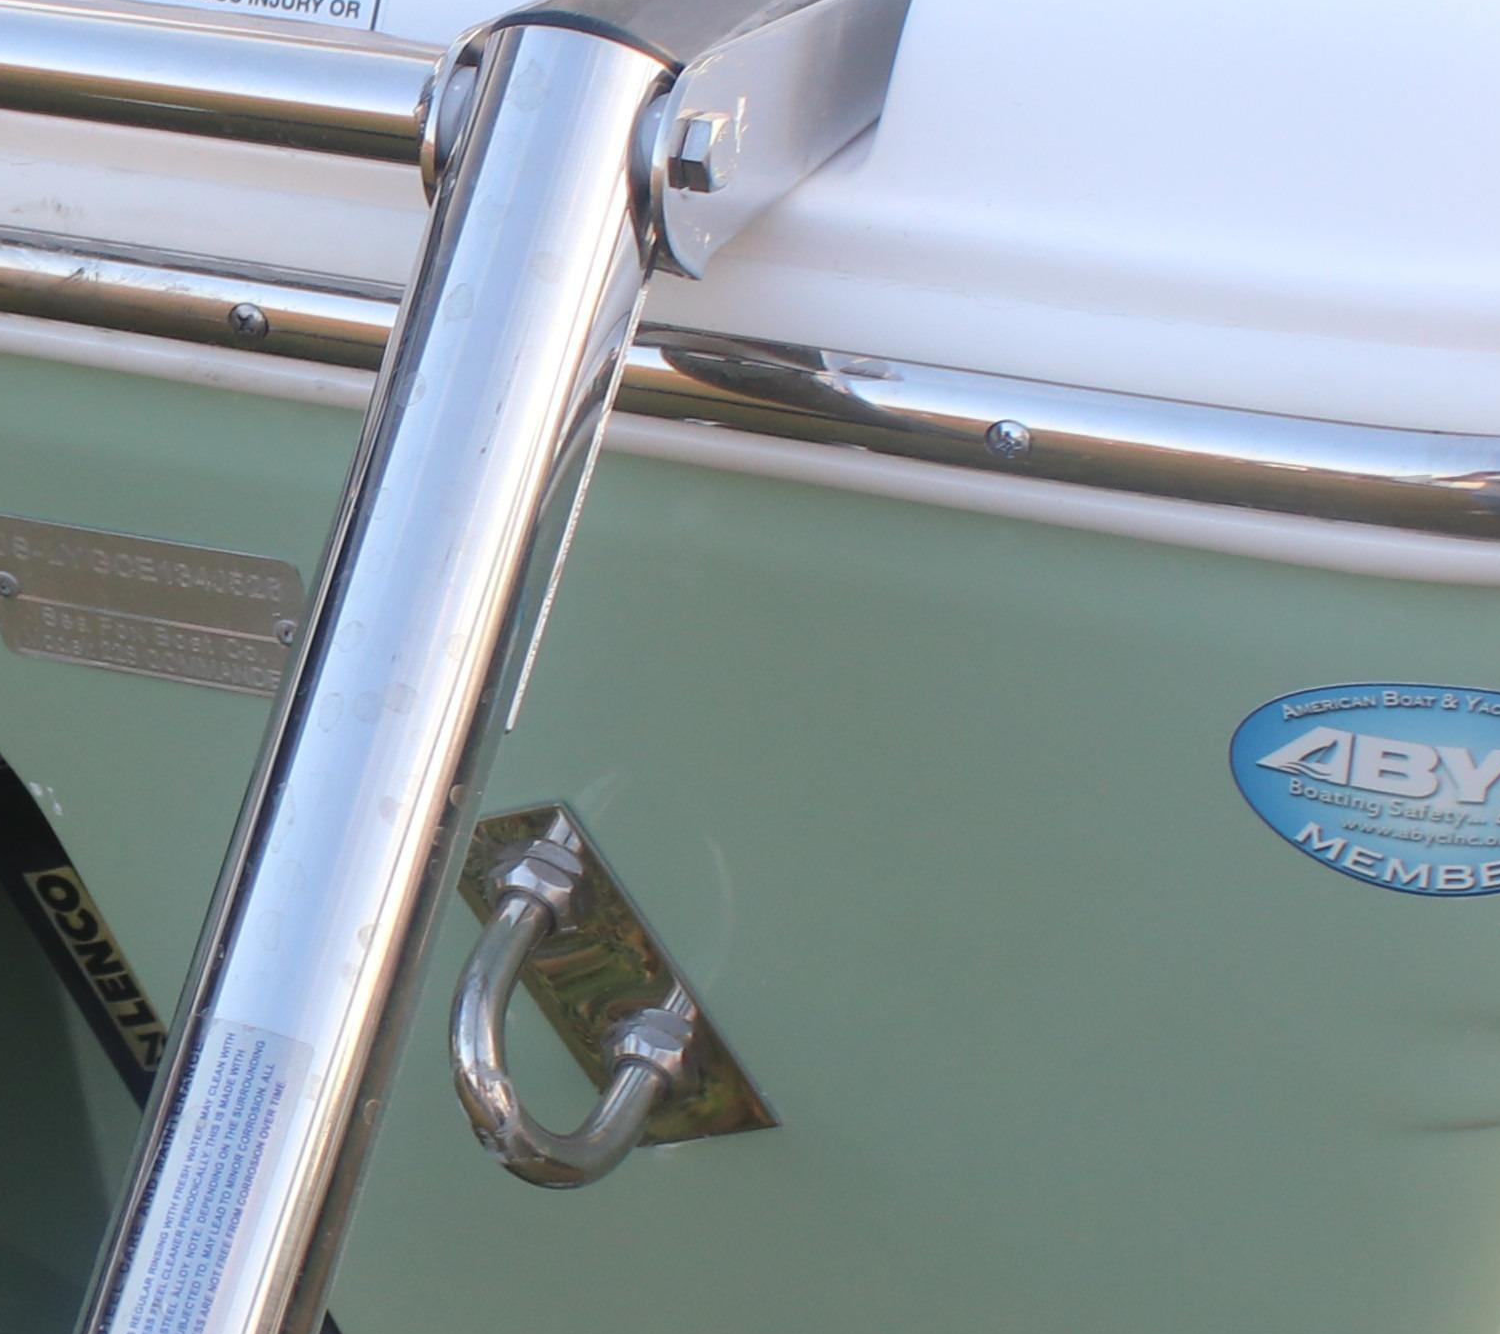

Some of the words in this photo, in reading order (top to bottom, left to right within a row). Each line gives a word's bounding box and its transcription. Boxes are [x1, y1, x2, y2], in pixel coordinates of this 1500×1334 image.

[1280, 693, 1378, 722] AMERICAN
[1382, 690, 1437, 709] BOAT
[1441, 692, 1459, 710] &
[1288, 777, 1382, 817] Boating
[35, 874, 155, 1029] LENCO
[228, 1047, 246, 1076] WITH
[260, 1061, 275, 1083] ALL
[217, 1076, 236, 1109] MADE
[230, 1038, 266, 1119] SURROUNDING
[213, 1109, 225, 1122] IS
[223, 1118, 239, 1141] THE
[258, 1107, 276, 1139] OVER
[205, 1122, 221, 1148] THIS
[217, 1142, 231, 1159] ON
[128, 1275, 154, 1329] REGULAR
[146, 1229, 170, 1275] RINSING
[162, 1201, 179, 1230] WITH
[171, 1162, 192, 1200] FRESH
[198, 1097, 214, 1120] MAY
[206, 1058, 226, 1097] CLEAN
[218, 1030, 236, 1059] WITH
[225, 1152, 245, 1189] MINOR
[235, 1139, 266, 1206] CORROSION
[195, 1160, 225, 1224] DEPENDING
[219, 1189, 232, 1206] TO
[209, 1205, 227, 1236] LEAD
[224, 1206, 243, 1239] FROM
[160, 1228, 186, 1281] CLEANER
[201, 1236, 216, 1259] MAY
[214, 1239, 232, 1269] FREE
[206, 1269, 223, 1294] NOT
[198, 1293, 215, 1317] ARE
